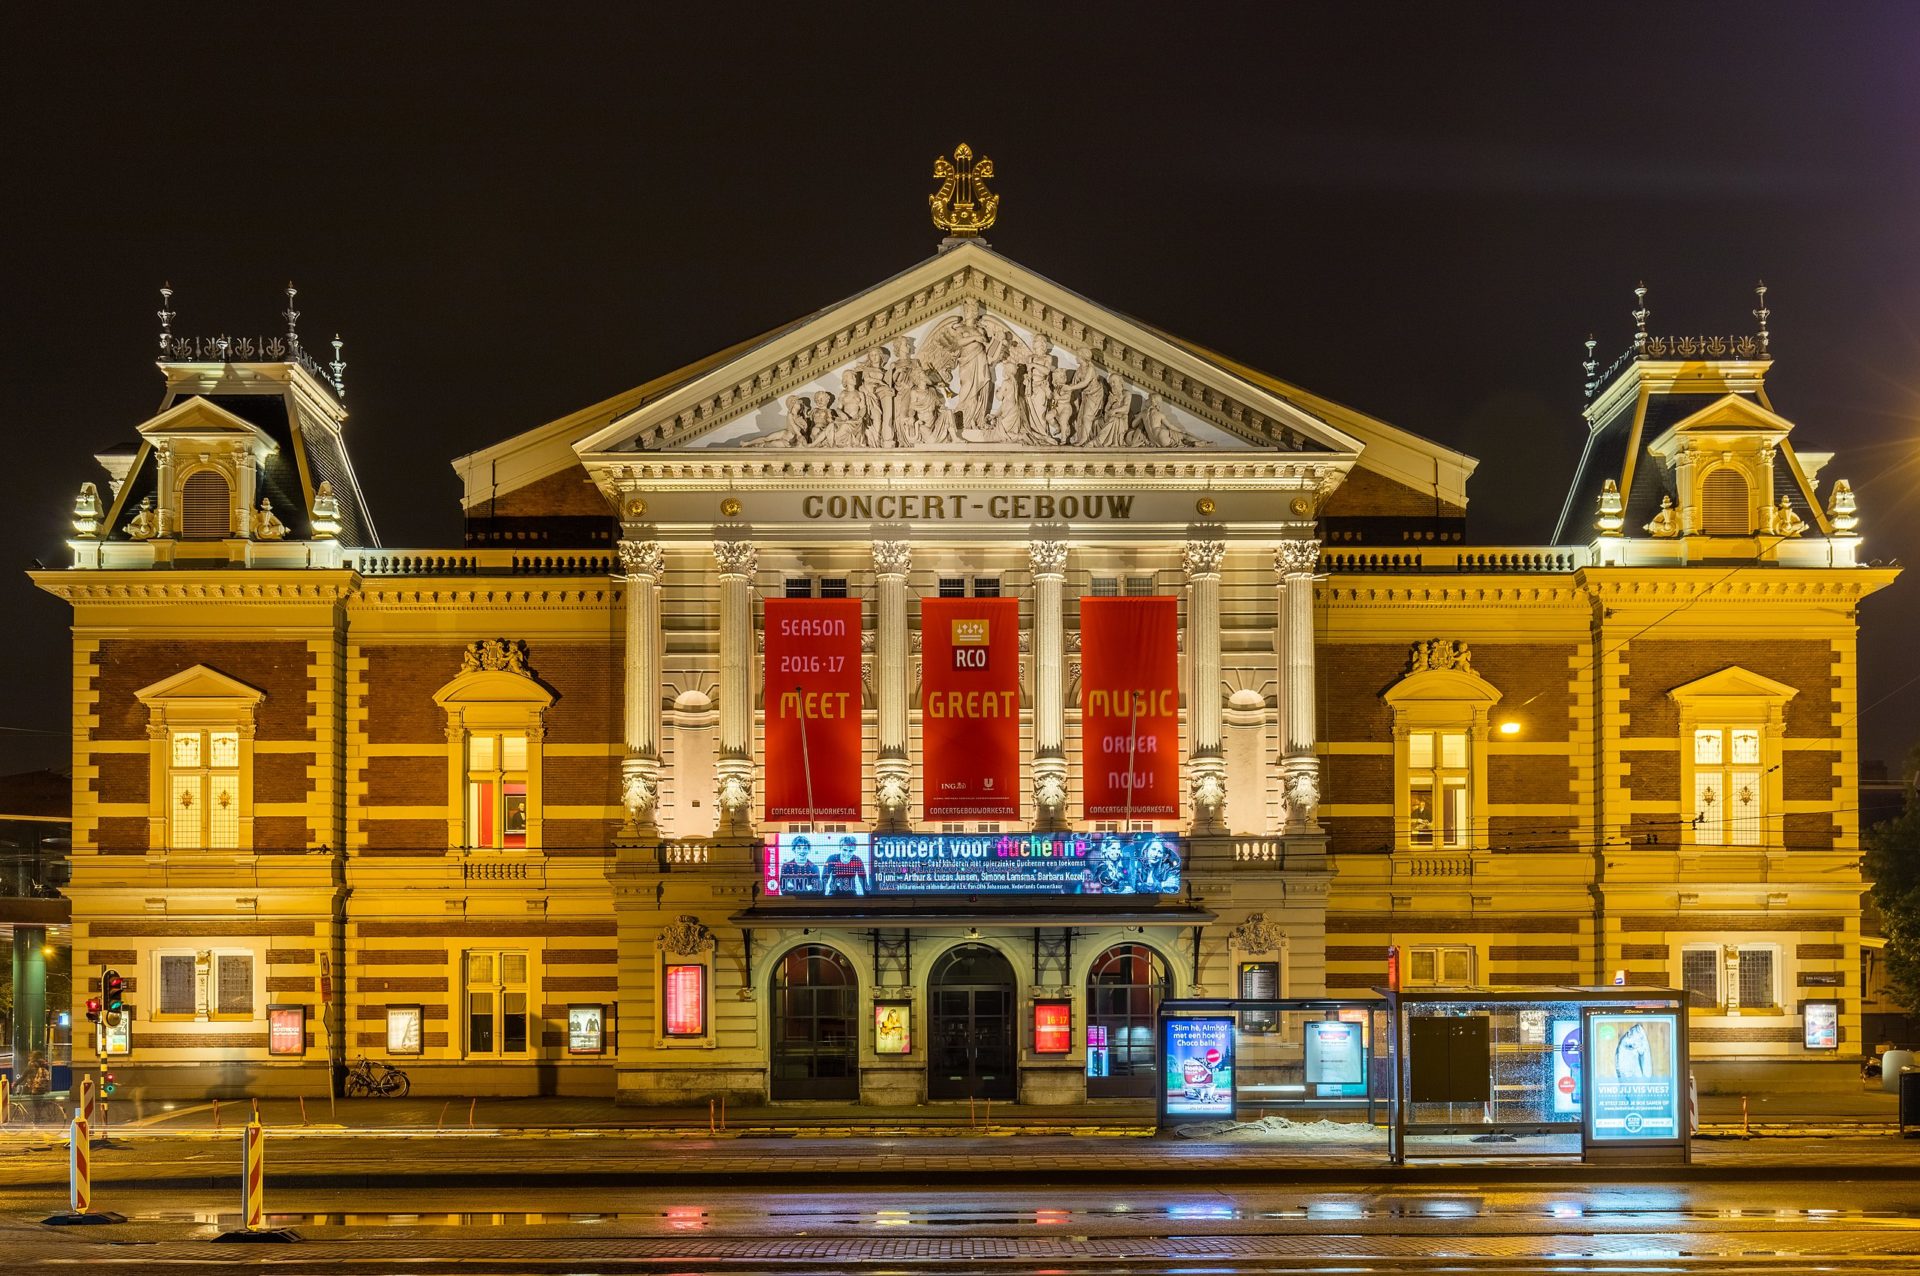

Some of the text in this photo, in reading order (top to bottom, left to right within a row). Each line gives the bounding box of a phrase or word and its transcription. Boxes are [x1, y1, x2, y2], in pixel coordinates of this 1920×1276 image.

[802, 494, 1134, 519] CONCERT-GEBOUW
[781, 619, 845, 636] SEASON
[956, 649, 986, 667] RCO
[780, 692, 850, 719] MEET
[928, 691, 1015, 718] GREAT
[1088, 689, 1174, 717] MUSIC
[1102, 736, 1158, 753] ORDER
[1108, 771, 1154, 789] NOW!
[771, 807, 857, 815] CONCERTGEBUWORKEST.NL
[874, 835, 1086, 858] concert voor duchenne
[875, 872, 883, 881] 10
[883, 872, 896, 883] juni
[903, 872, 926, 881] Arthur
[926, 873, 932, 881] &
[933, 872, 954, 881] Lucas
[954, 871, 980, 882] Jussen,
[981, 871, 1006, 882] Simone
[1037, 871, 1064, 881] Barbara
[1176, 1039, 1199, 1047] Choco
[1202, 1032, 1226, 1040] hoekje
[1598, 1086, 1669, 1094] VIND JIJ VIS VIES?
